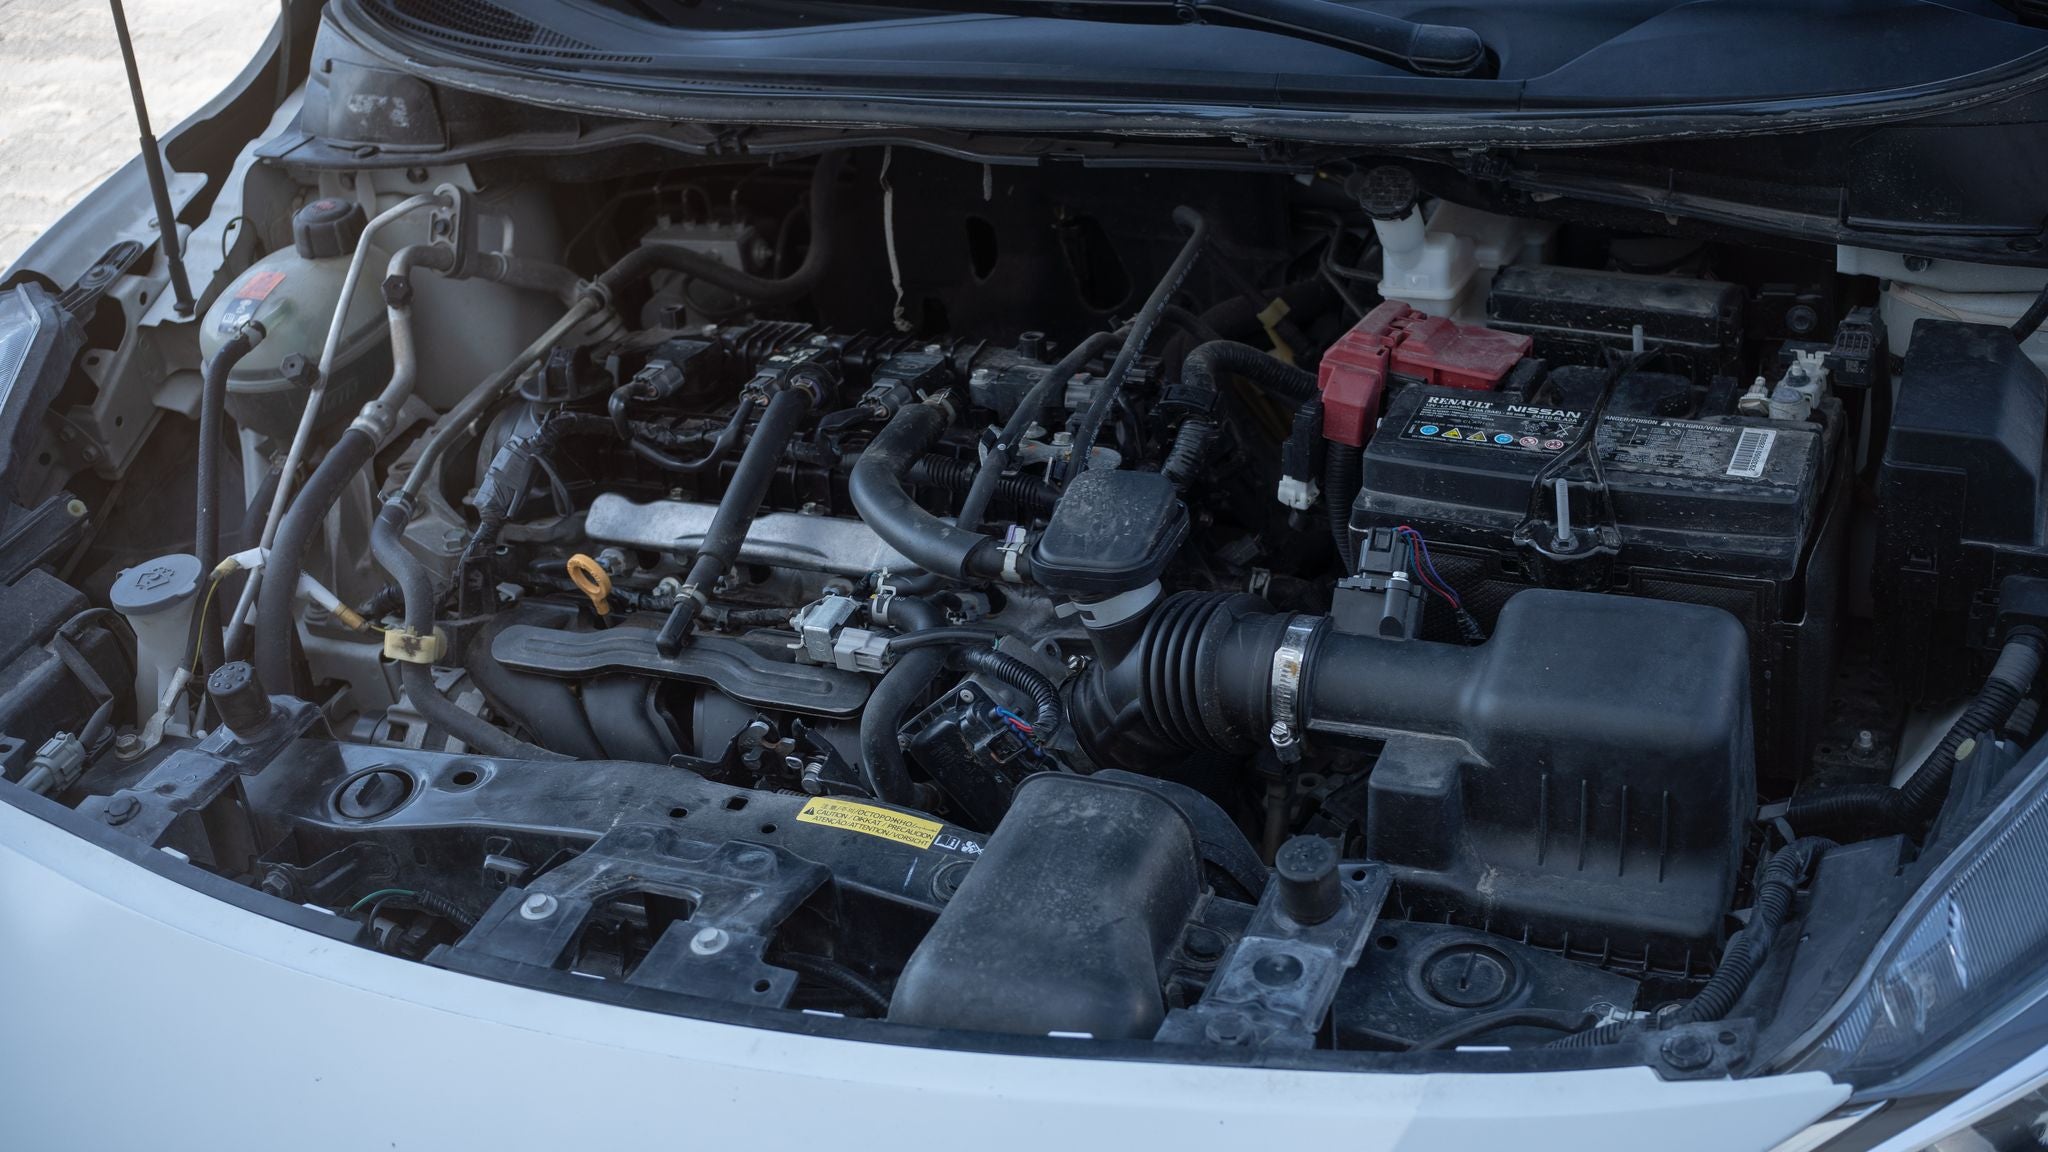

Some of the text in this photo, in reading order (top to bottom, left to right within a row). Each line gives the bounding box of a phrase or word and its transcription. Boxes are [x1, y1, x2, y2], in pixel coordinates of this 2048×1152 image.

[1428, 396, 1493, 409] RENAULT
[1507, 404, 1581, 419] NISSAN
[1604, 415, 1735, 433] ANGER/POISON PELIGRO/VENENO
[816, 810, 848, 819] CAUTION
